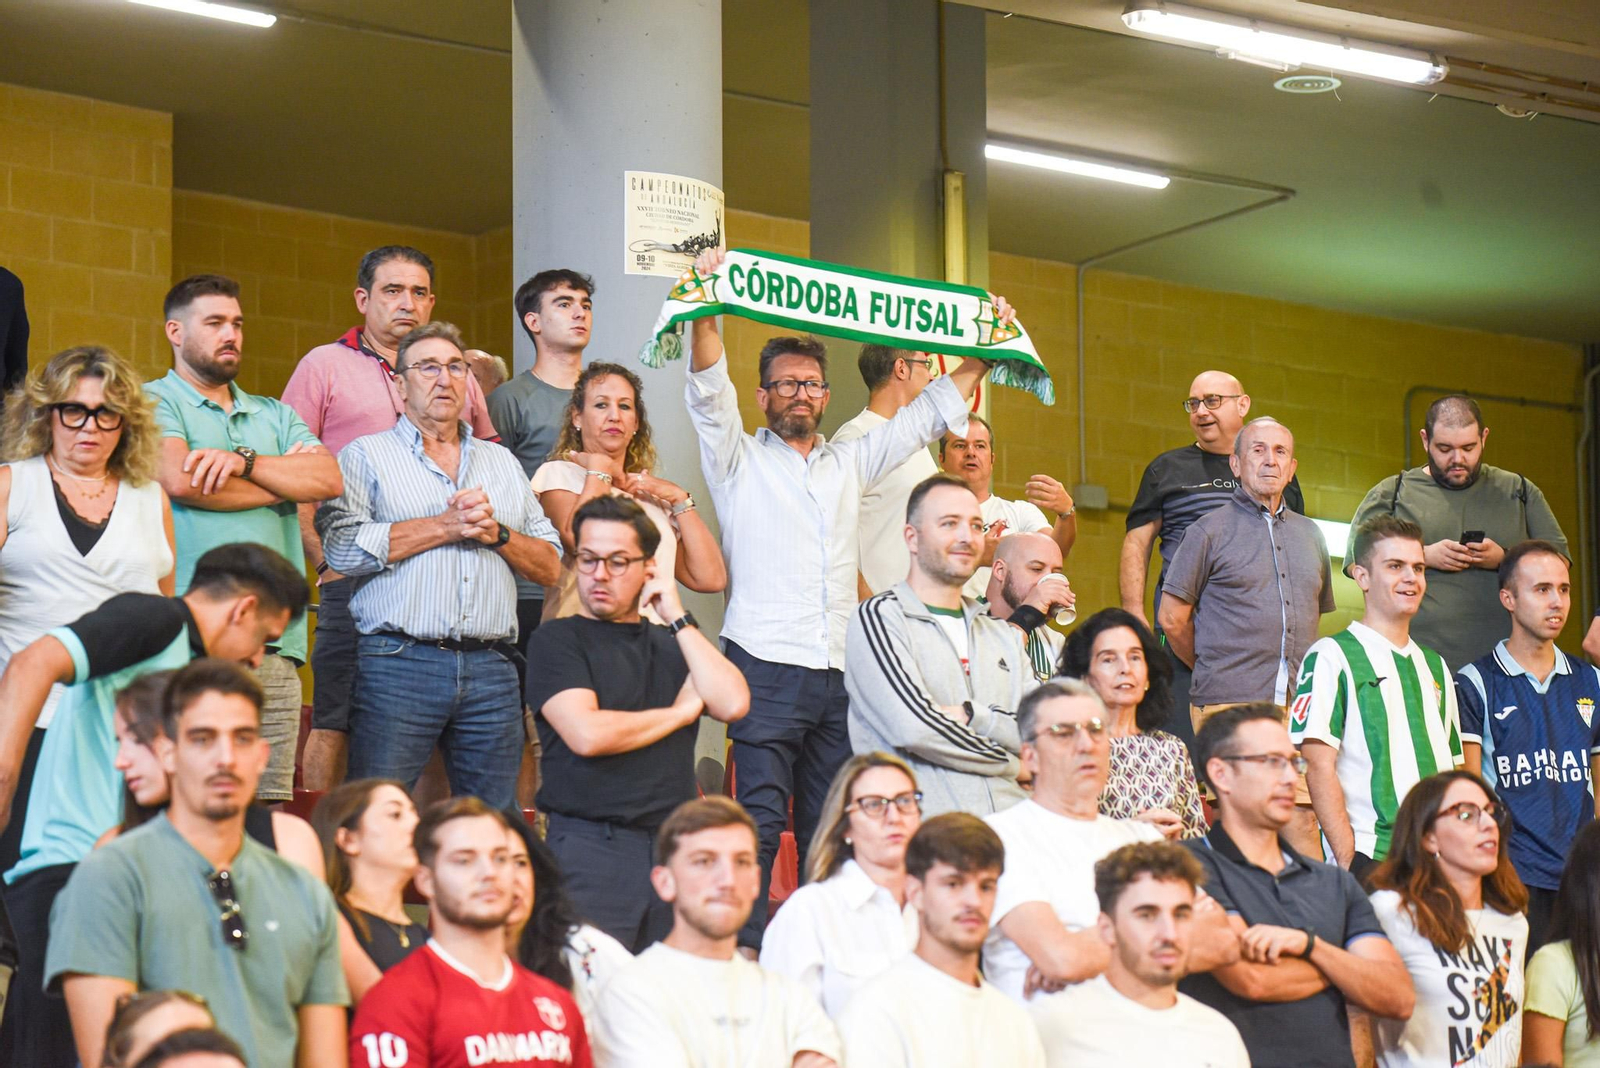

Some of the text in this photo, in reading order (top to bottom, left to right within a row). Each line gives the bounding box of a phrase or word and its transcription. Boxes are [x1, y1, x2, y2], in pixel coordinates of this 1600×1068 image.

[631, 177, 706, 202] CAMPEONATOS
[636, 254, 655, 263] 09-10
[728, 261, 964, 337] CÓRDOBA FUTSAL
[1433, 935, 1512, 974] MAK
[362, 1031, 409, 1068] 10
[464, 1029, 573, 1067] DANMARK
